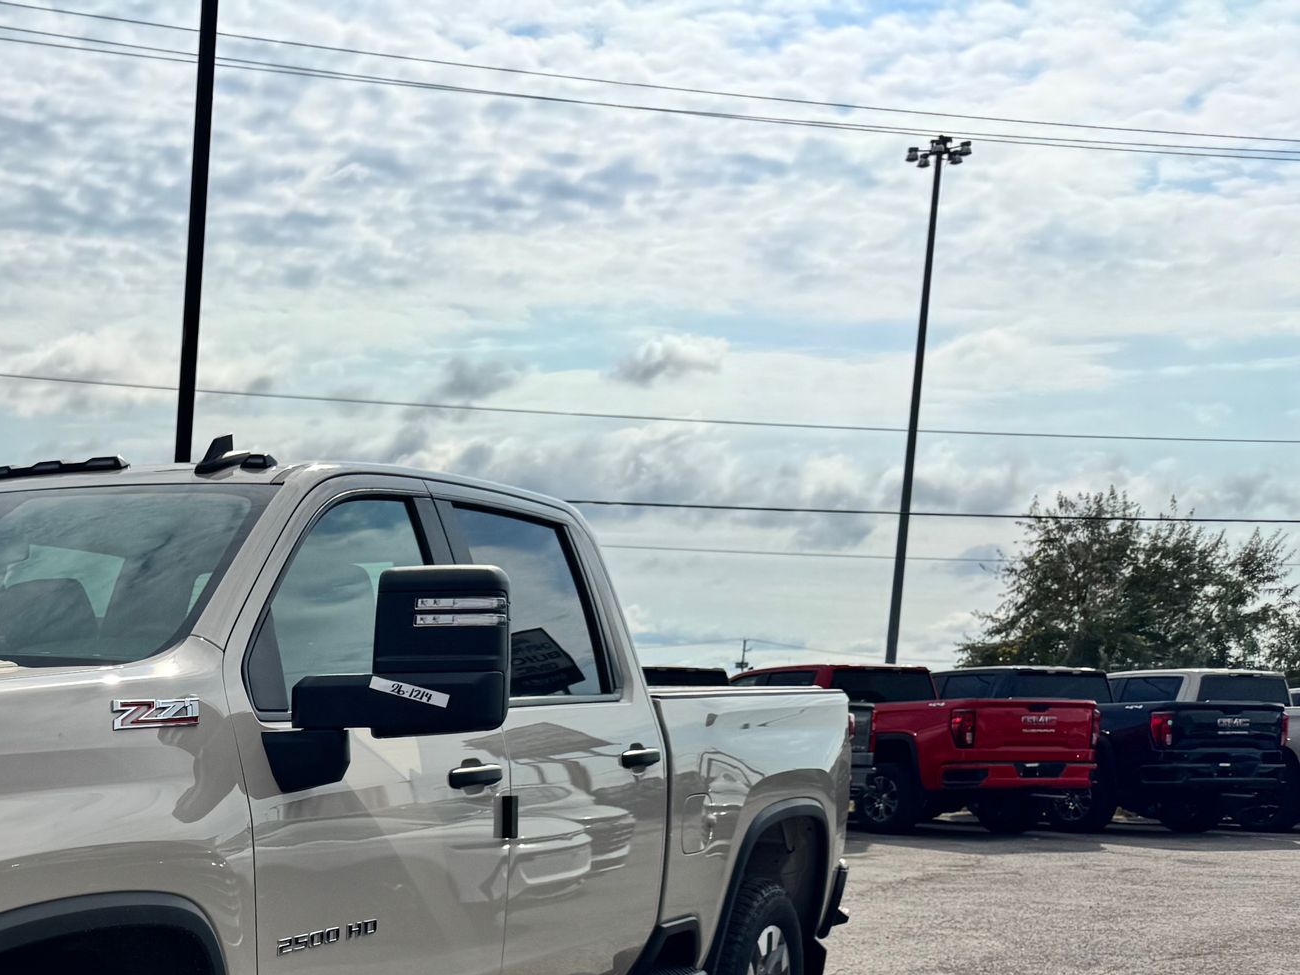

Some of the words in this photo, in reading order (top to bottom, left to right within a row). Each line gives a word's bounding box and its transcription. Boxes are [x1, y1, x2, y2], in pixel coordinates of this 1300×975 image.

[111, 697, 200, 732] Z71
[277, 926, 340, 957] 2500
[346, 918, 377, 941] HD
